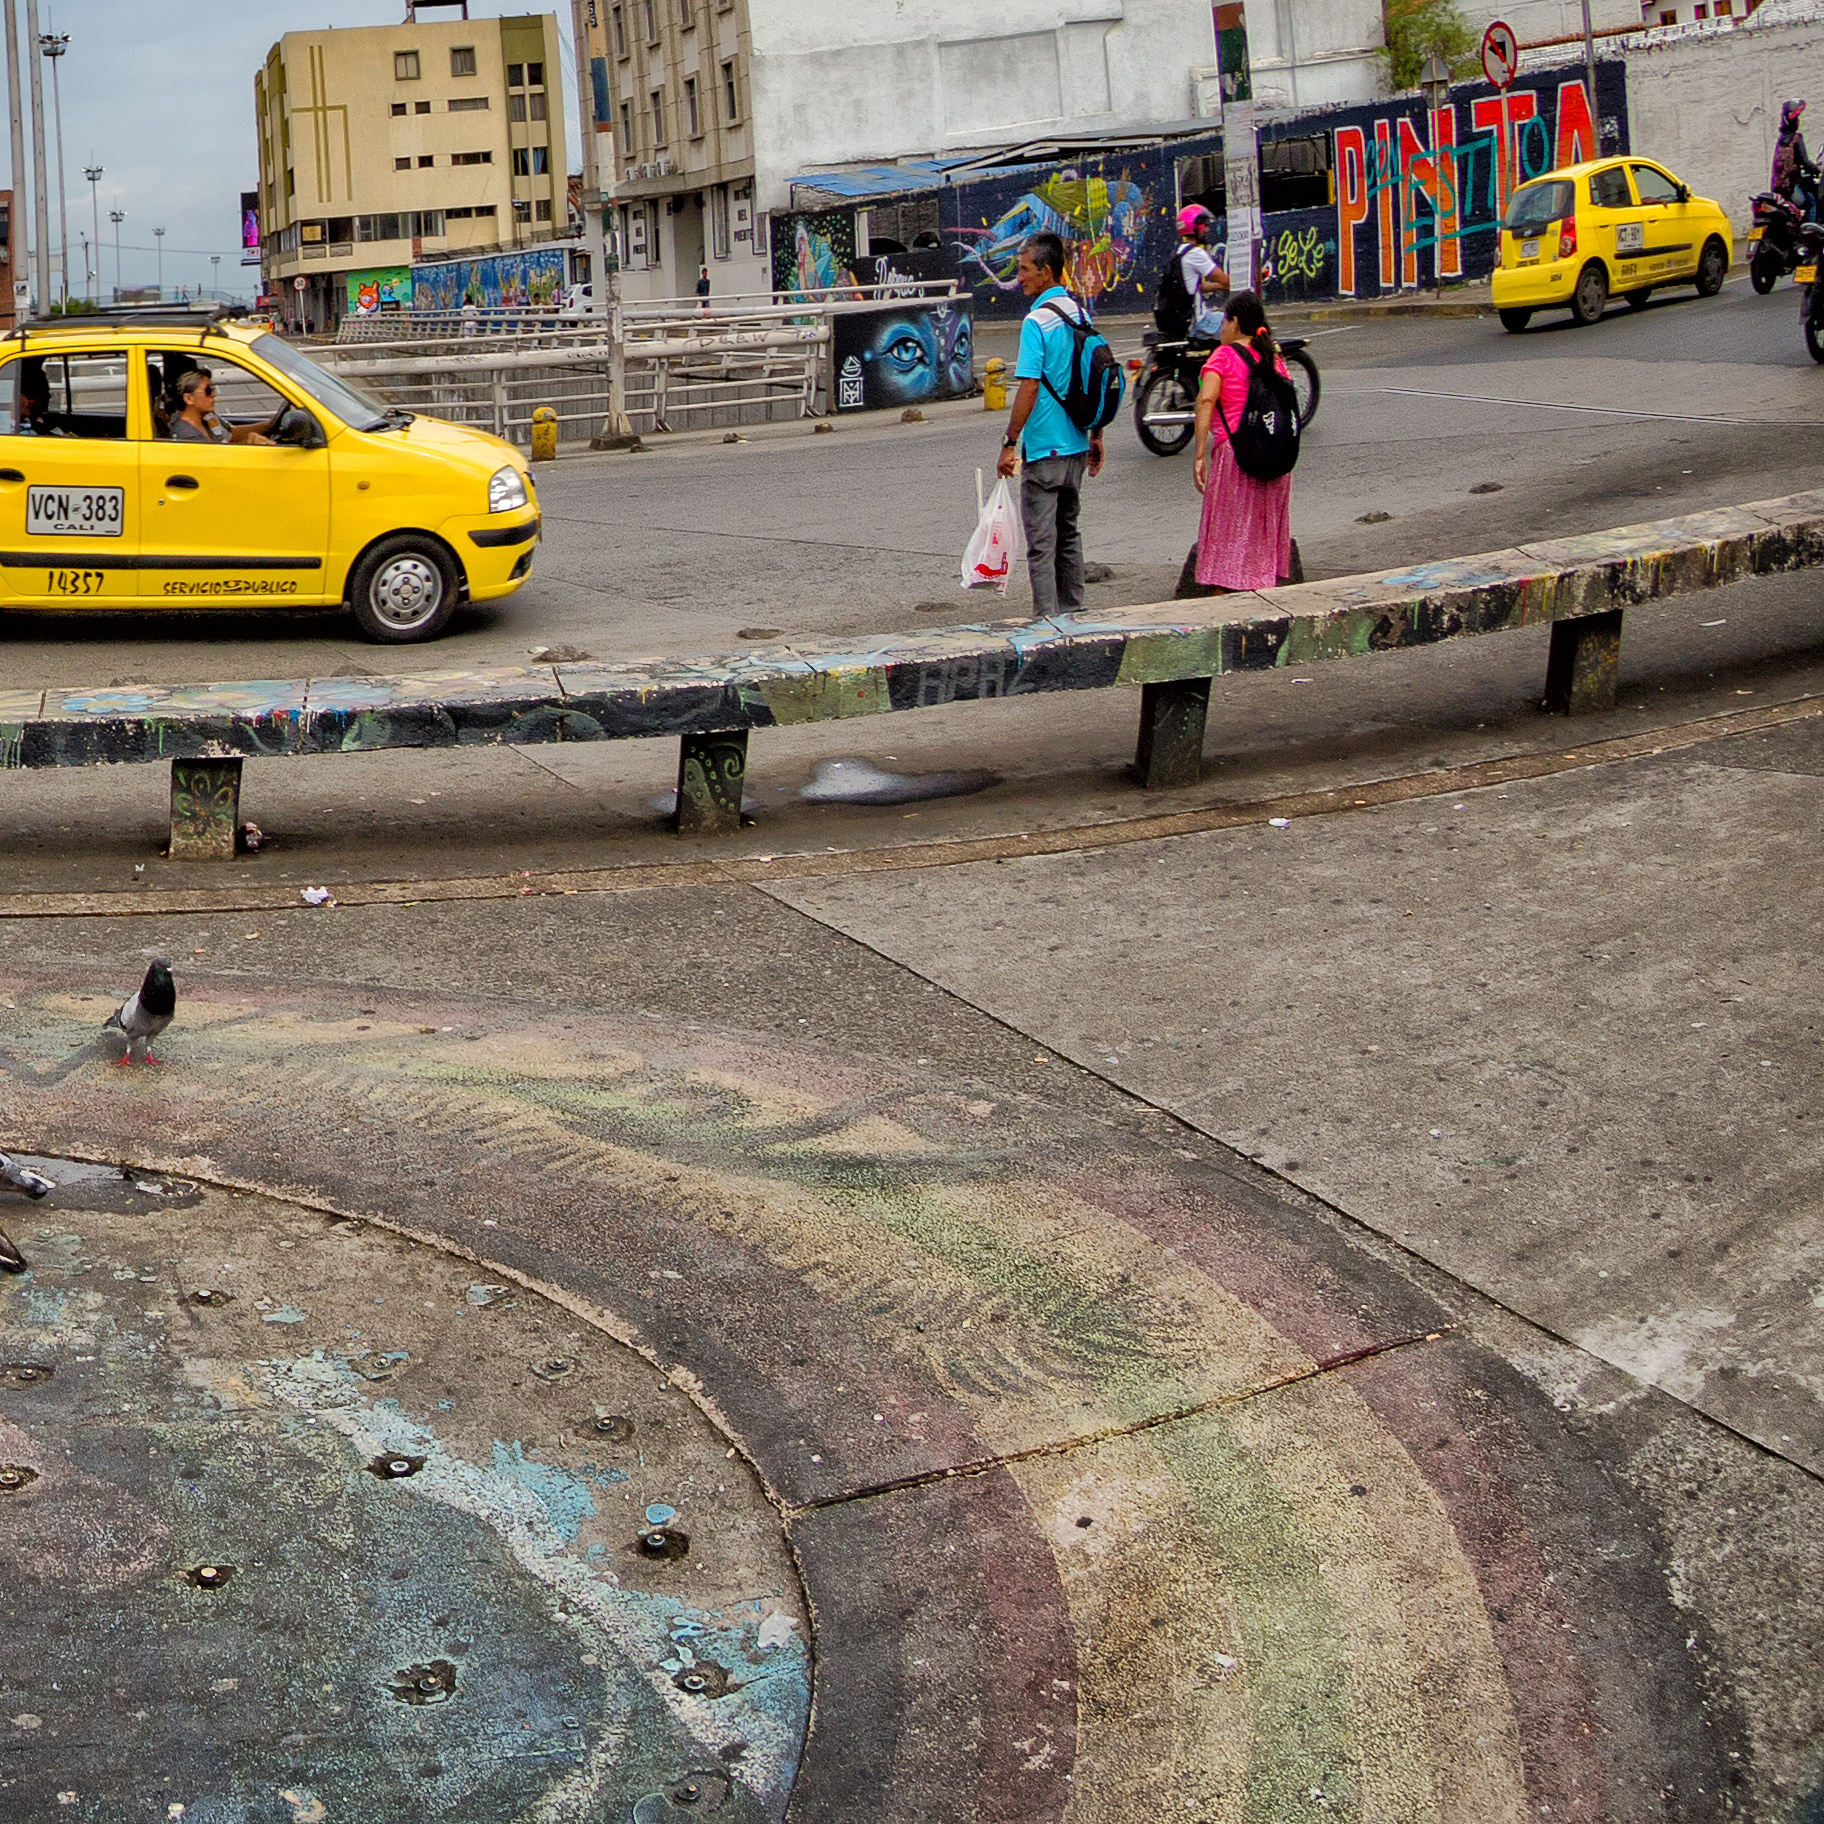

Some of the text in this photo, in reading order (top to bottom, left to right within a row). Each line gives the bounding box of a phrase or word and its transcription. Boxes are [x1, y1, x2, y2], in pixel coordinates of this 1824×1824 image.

[53, 522, 95, 531] CALI
[47, 571, 104, 594] 14357
[163, 580, 298, 594] SERVICIO PUBLICO
